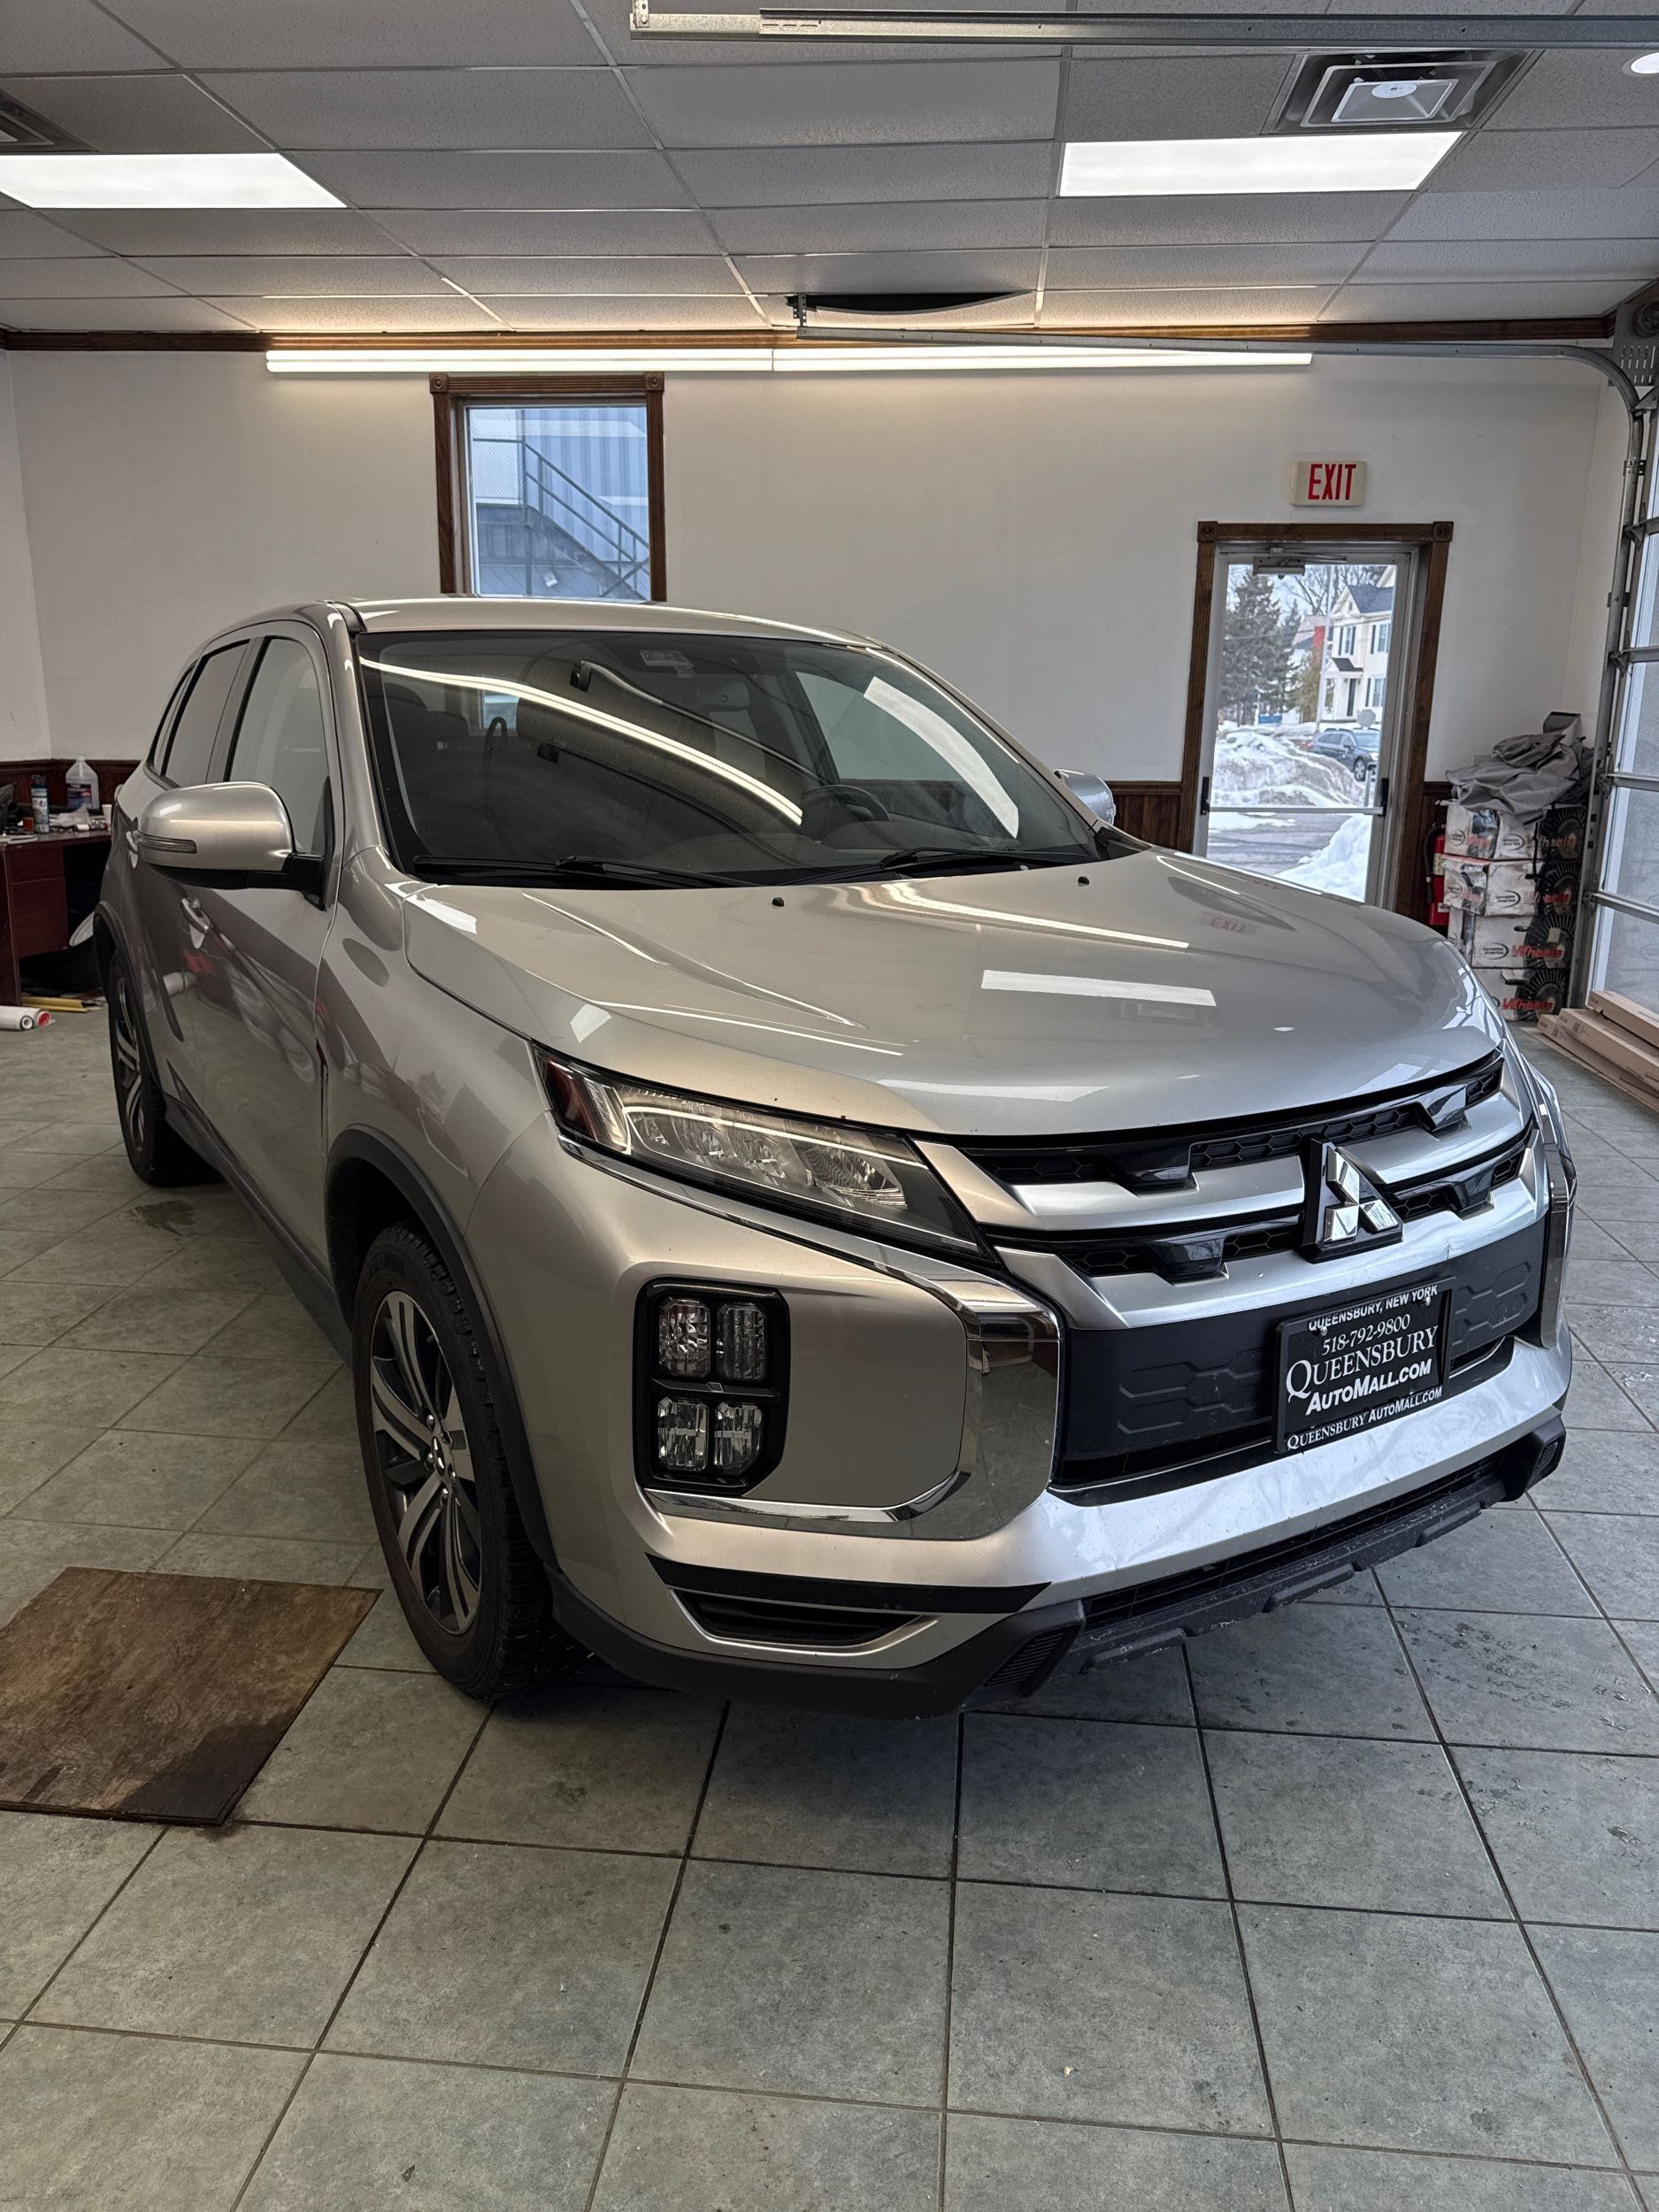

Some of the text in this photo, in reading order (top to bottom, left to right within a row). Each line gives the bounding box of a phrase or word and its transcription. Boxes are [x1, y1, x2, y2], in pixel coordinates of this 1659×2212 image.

[1308, 464, 1356, 500] EXIT
[1308, 1285, 1438, 1332] QUEENSBURY, NEW YORK
[1321, 1314, 1411, 1356] 518-792-9800
[1286, 1325, 1439, 1402] QUEENSBURY
[1286, 1413, 1367, 1451] QUEENSBURY
